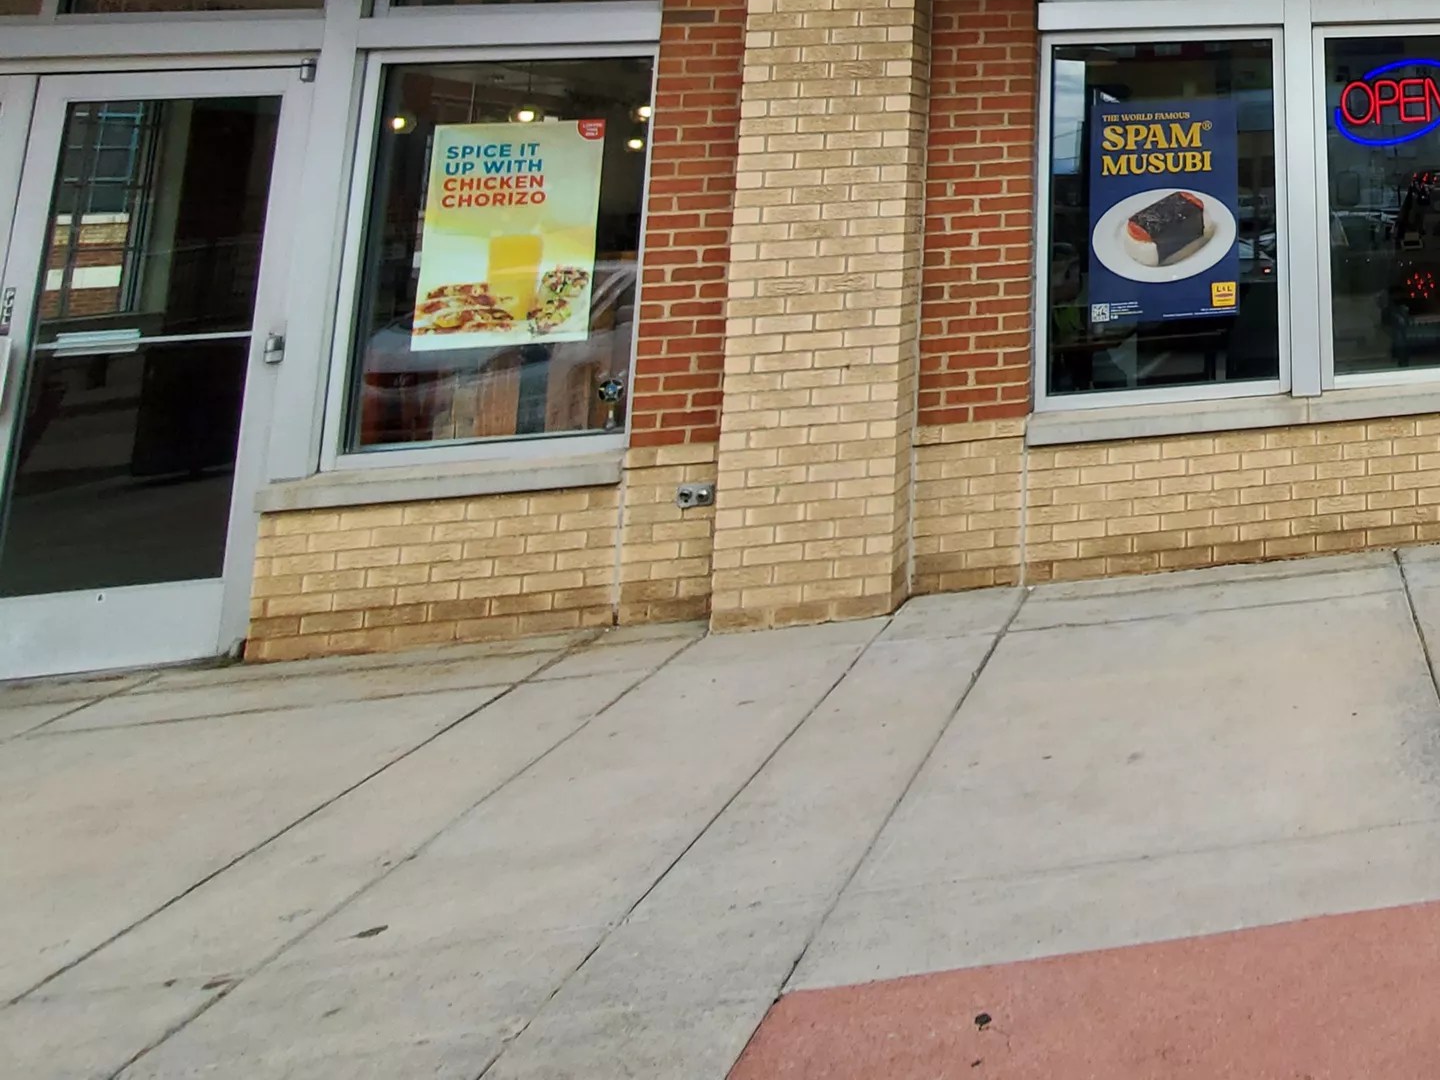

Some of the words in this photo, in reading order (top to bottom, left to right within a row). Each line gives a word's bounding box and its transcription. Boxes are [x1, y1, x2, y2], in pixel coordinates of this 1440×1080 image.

[1102, 114, 1119, 122] THE
[1121, 113, 1153, 121] WORLD
[1155, 111, 1190, 119] FAMOUS
[447, 143, 511, 159] SPICE
[520, 142, 539, 157] IT
[445, 161, 474, 175] UP
[484, 159, 542, 174] WITH
[1102, 151, 1212, 175] MUSUBI
[443, 175, 544, 191] CHICKEN
[441, 191, 545, 207] CHORIZO
